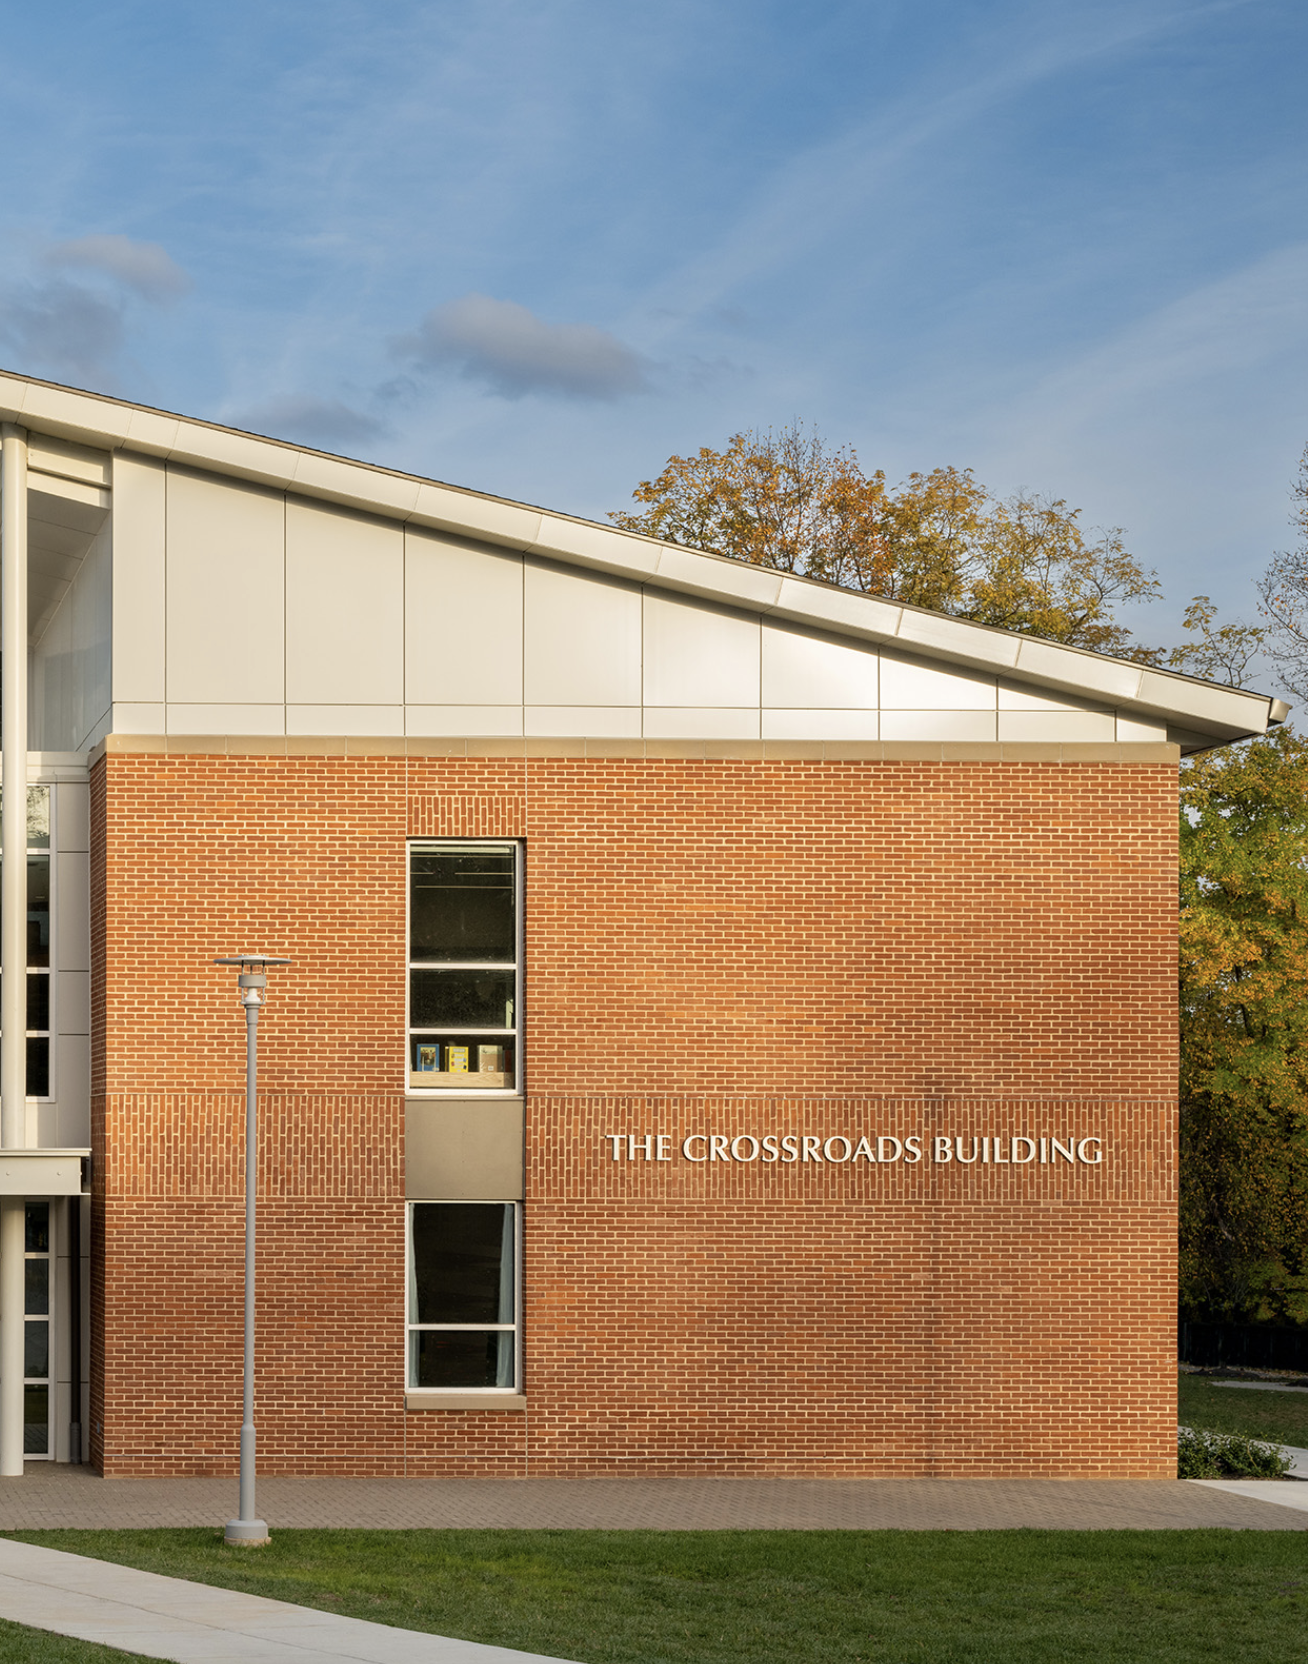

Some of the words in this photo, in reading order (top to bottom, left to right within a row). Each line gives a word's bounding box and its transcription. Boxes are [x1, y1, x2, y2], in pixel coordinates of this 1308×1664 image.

[606, 1134, 672, 1161] THE
[683, 1134, 922, 1164] CROSSROADS
[934, 1136, 1103, 1164] BUILDING
